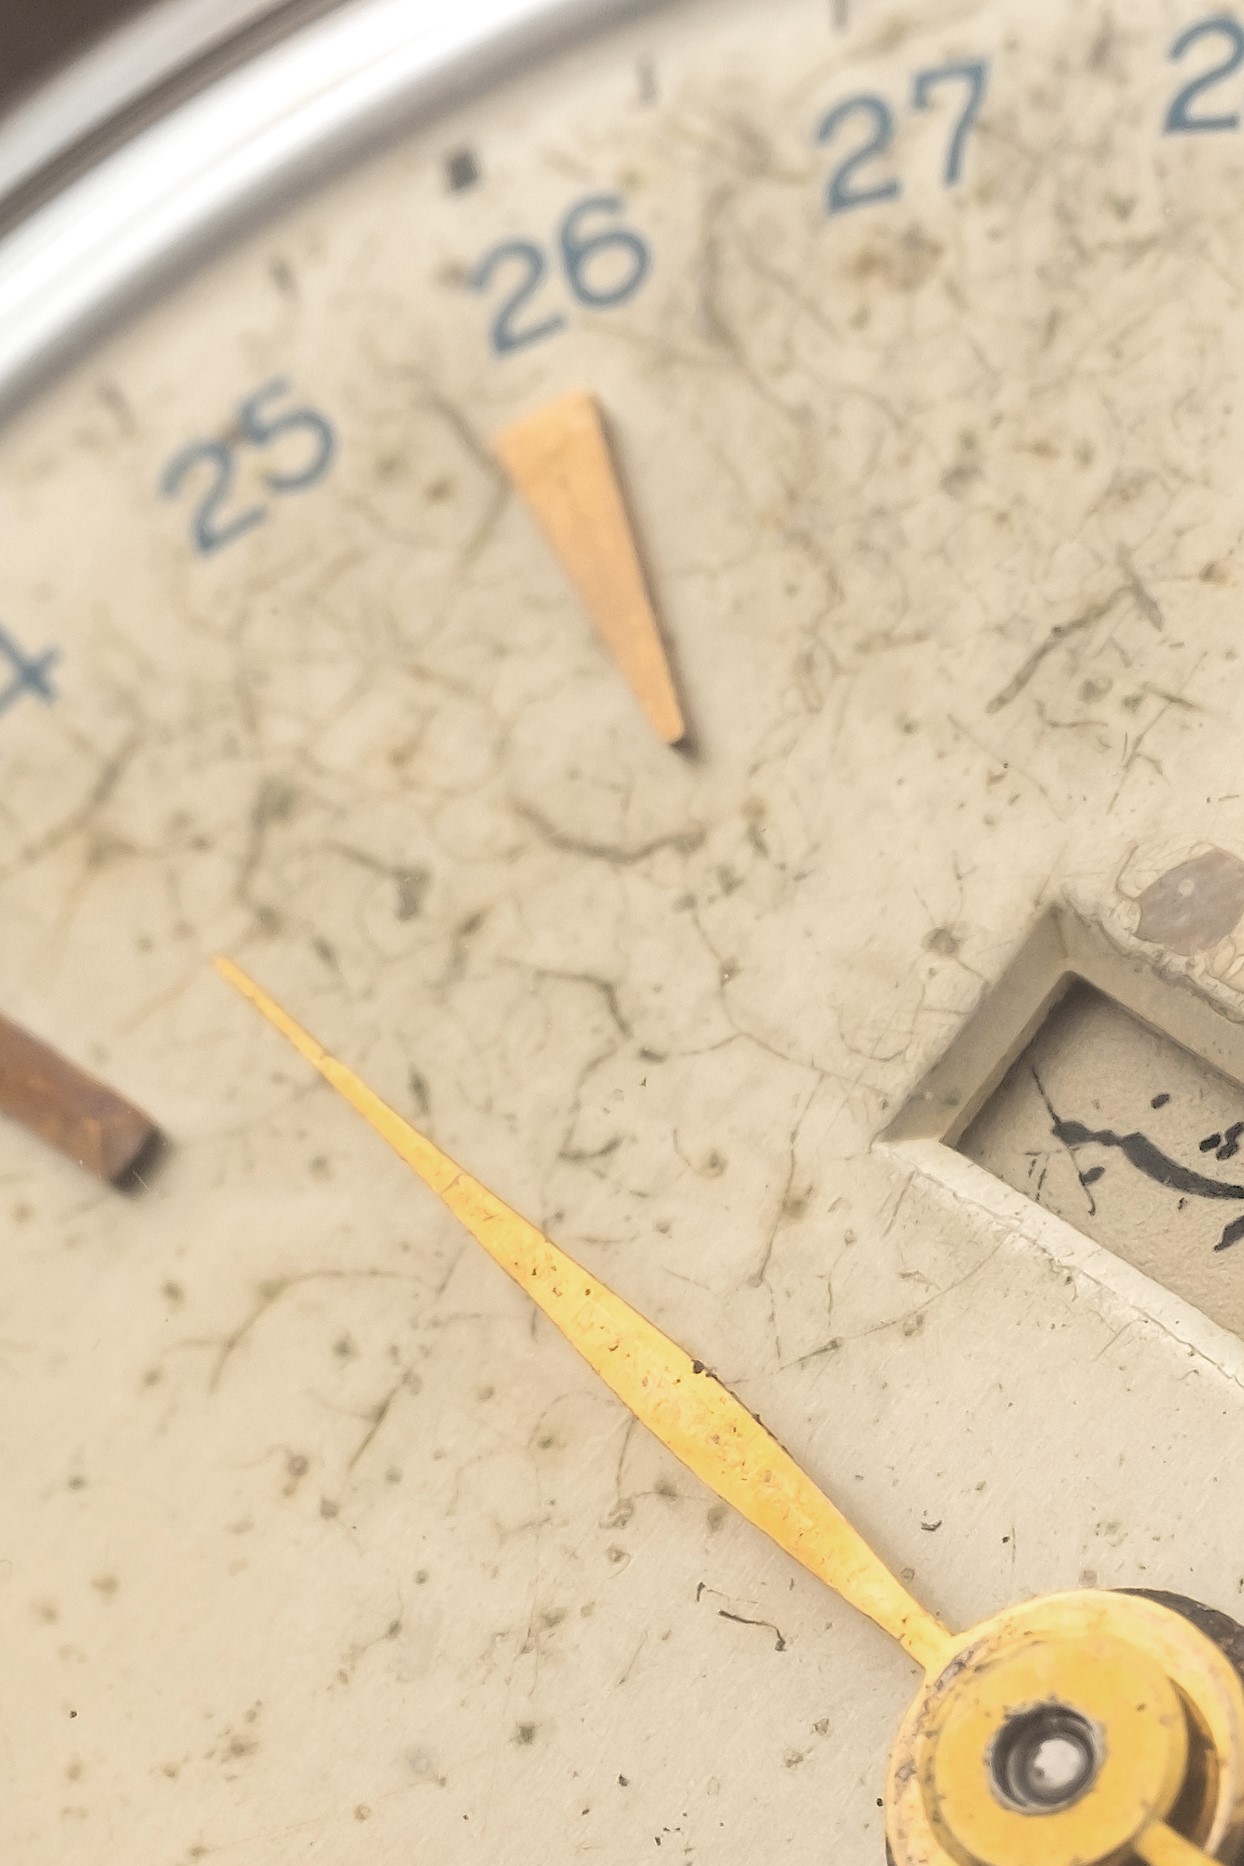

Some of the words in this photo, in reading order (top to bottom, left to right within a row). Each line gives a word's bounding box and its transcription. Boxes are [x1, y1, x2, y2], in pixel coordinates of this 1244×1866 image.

[814, 55, 993, 217] 27
[468, 192, 654, 360] 26
[158, 376, 340, 560] 25
